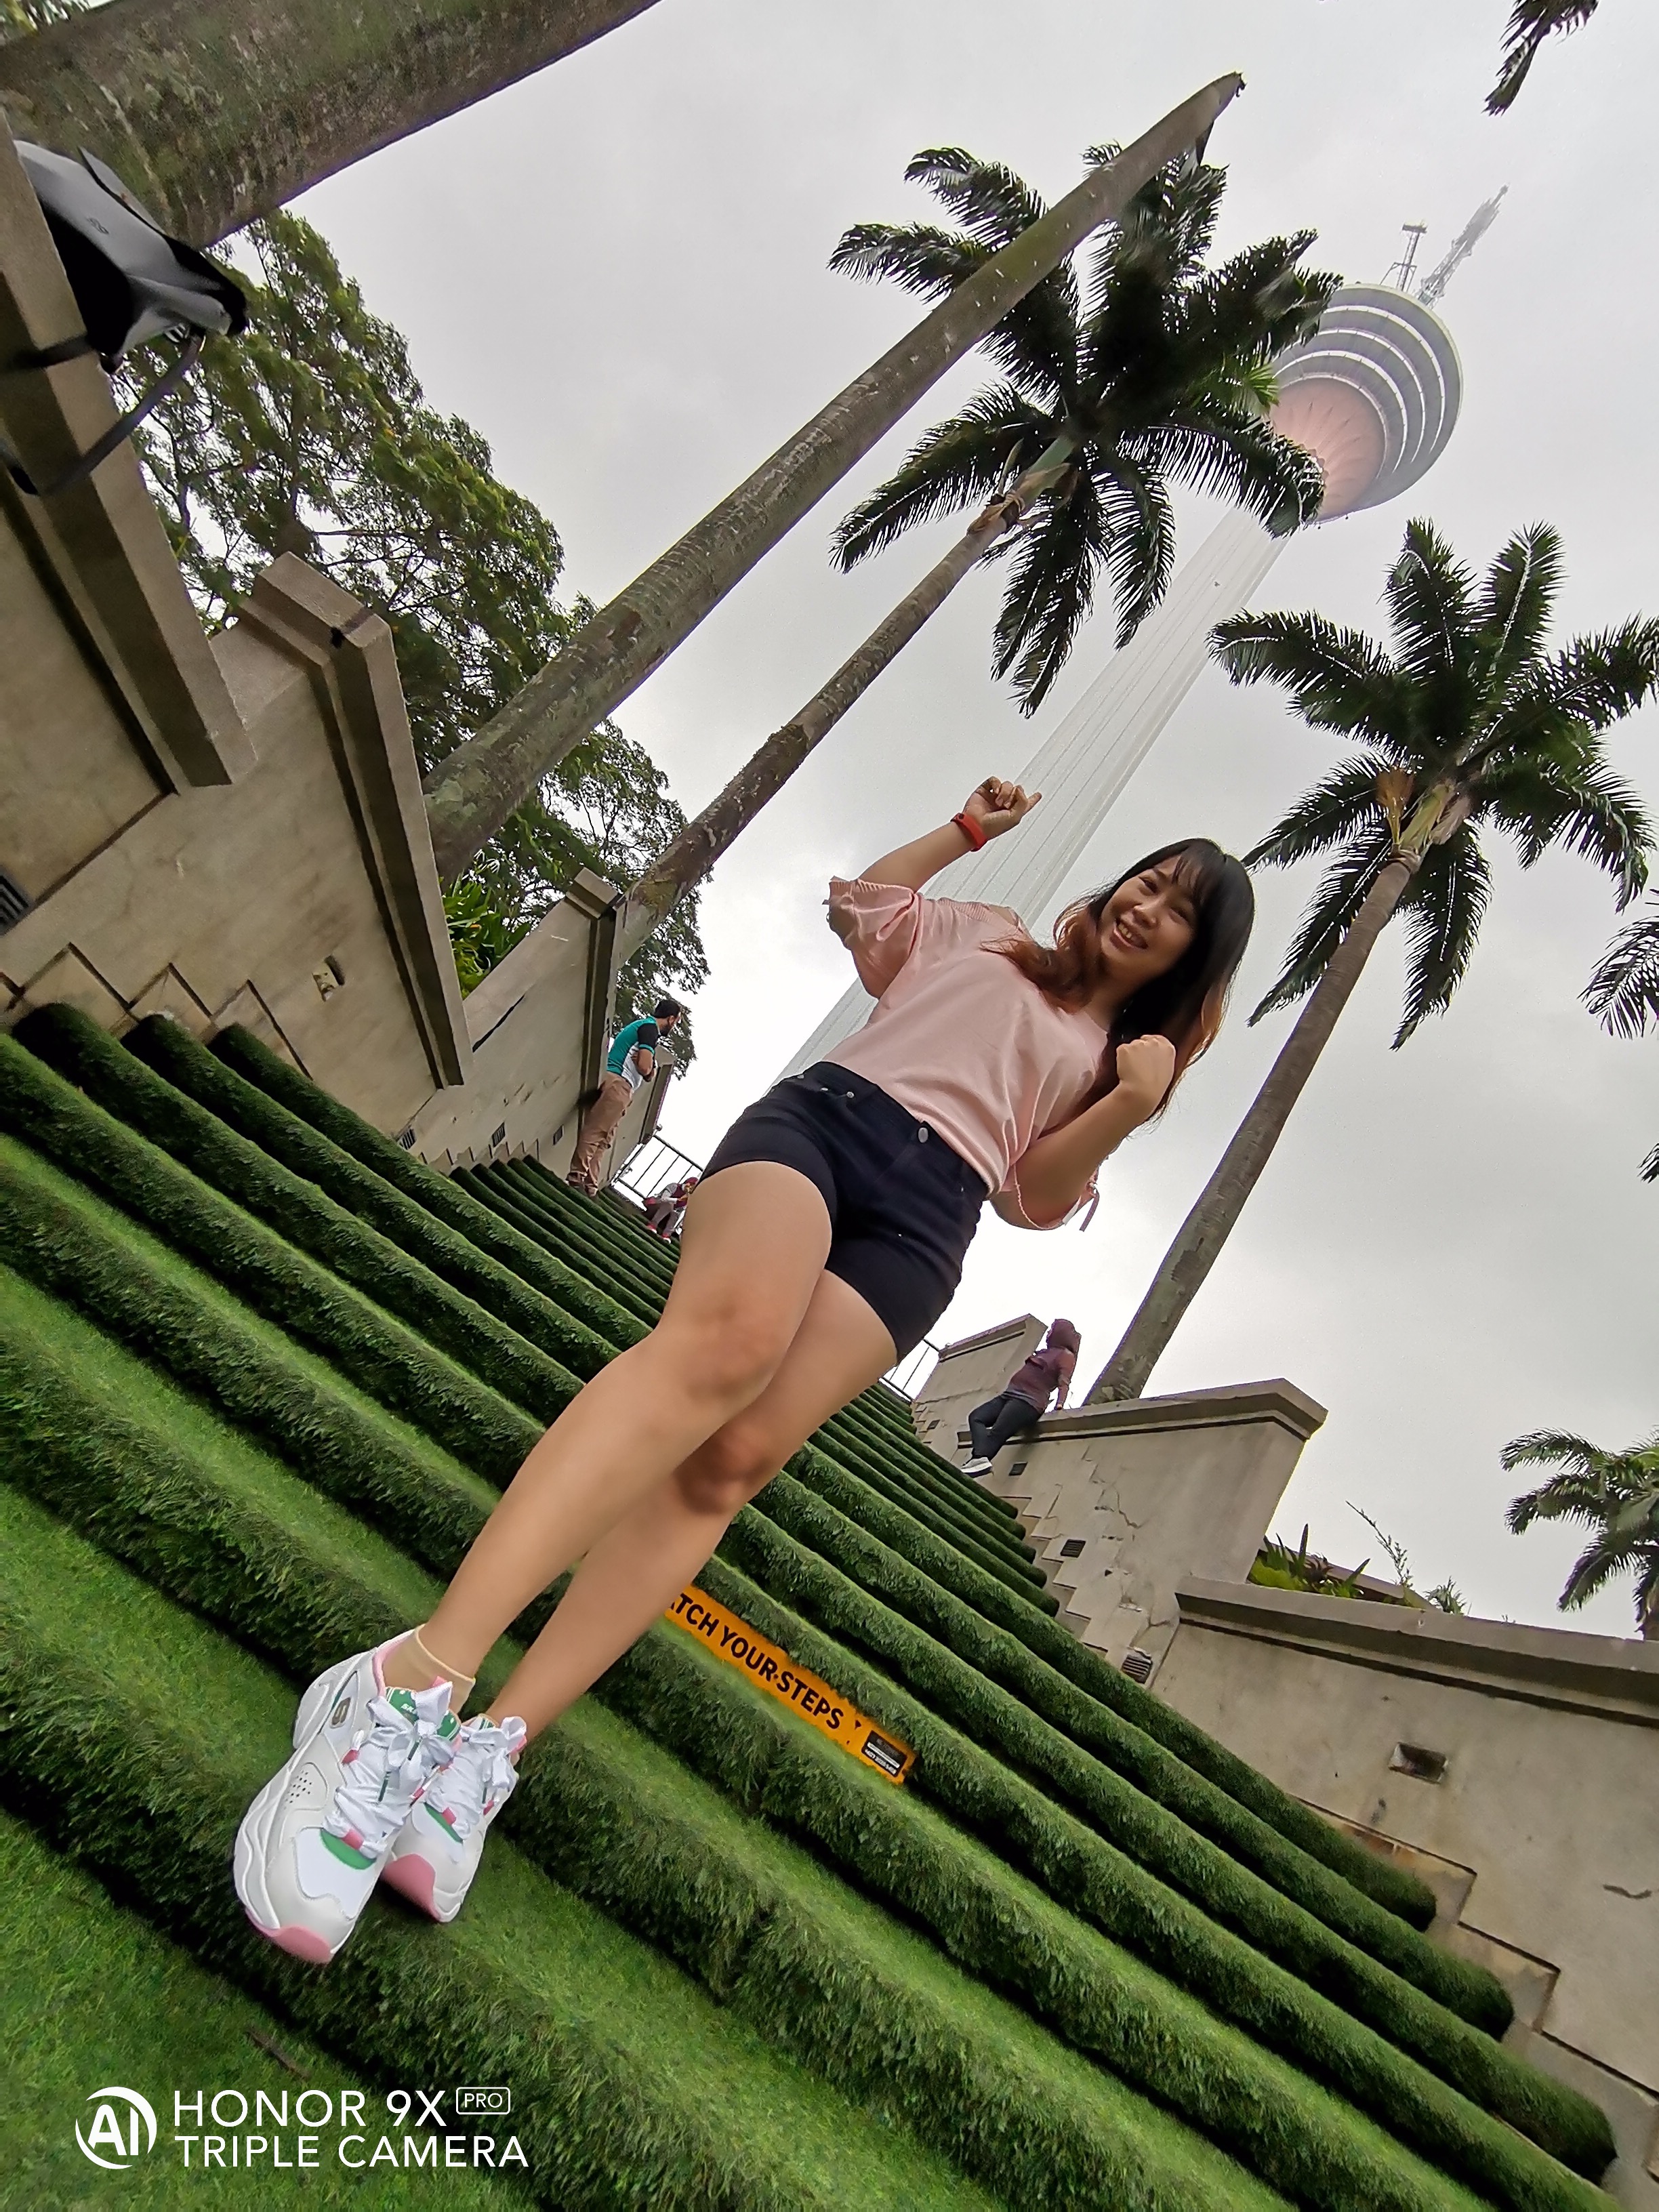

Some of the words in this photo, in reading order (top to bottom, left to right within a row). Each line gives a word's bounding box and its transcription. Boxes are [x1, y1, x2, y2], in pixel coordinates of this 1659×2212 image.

[671, 1592, 720, 1637] TCH
[720, 1624, 778, 1682] YOUR
[777, 1671, 844, 1729] STEPS
